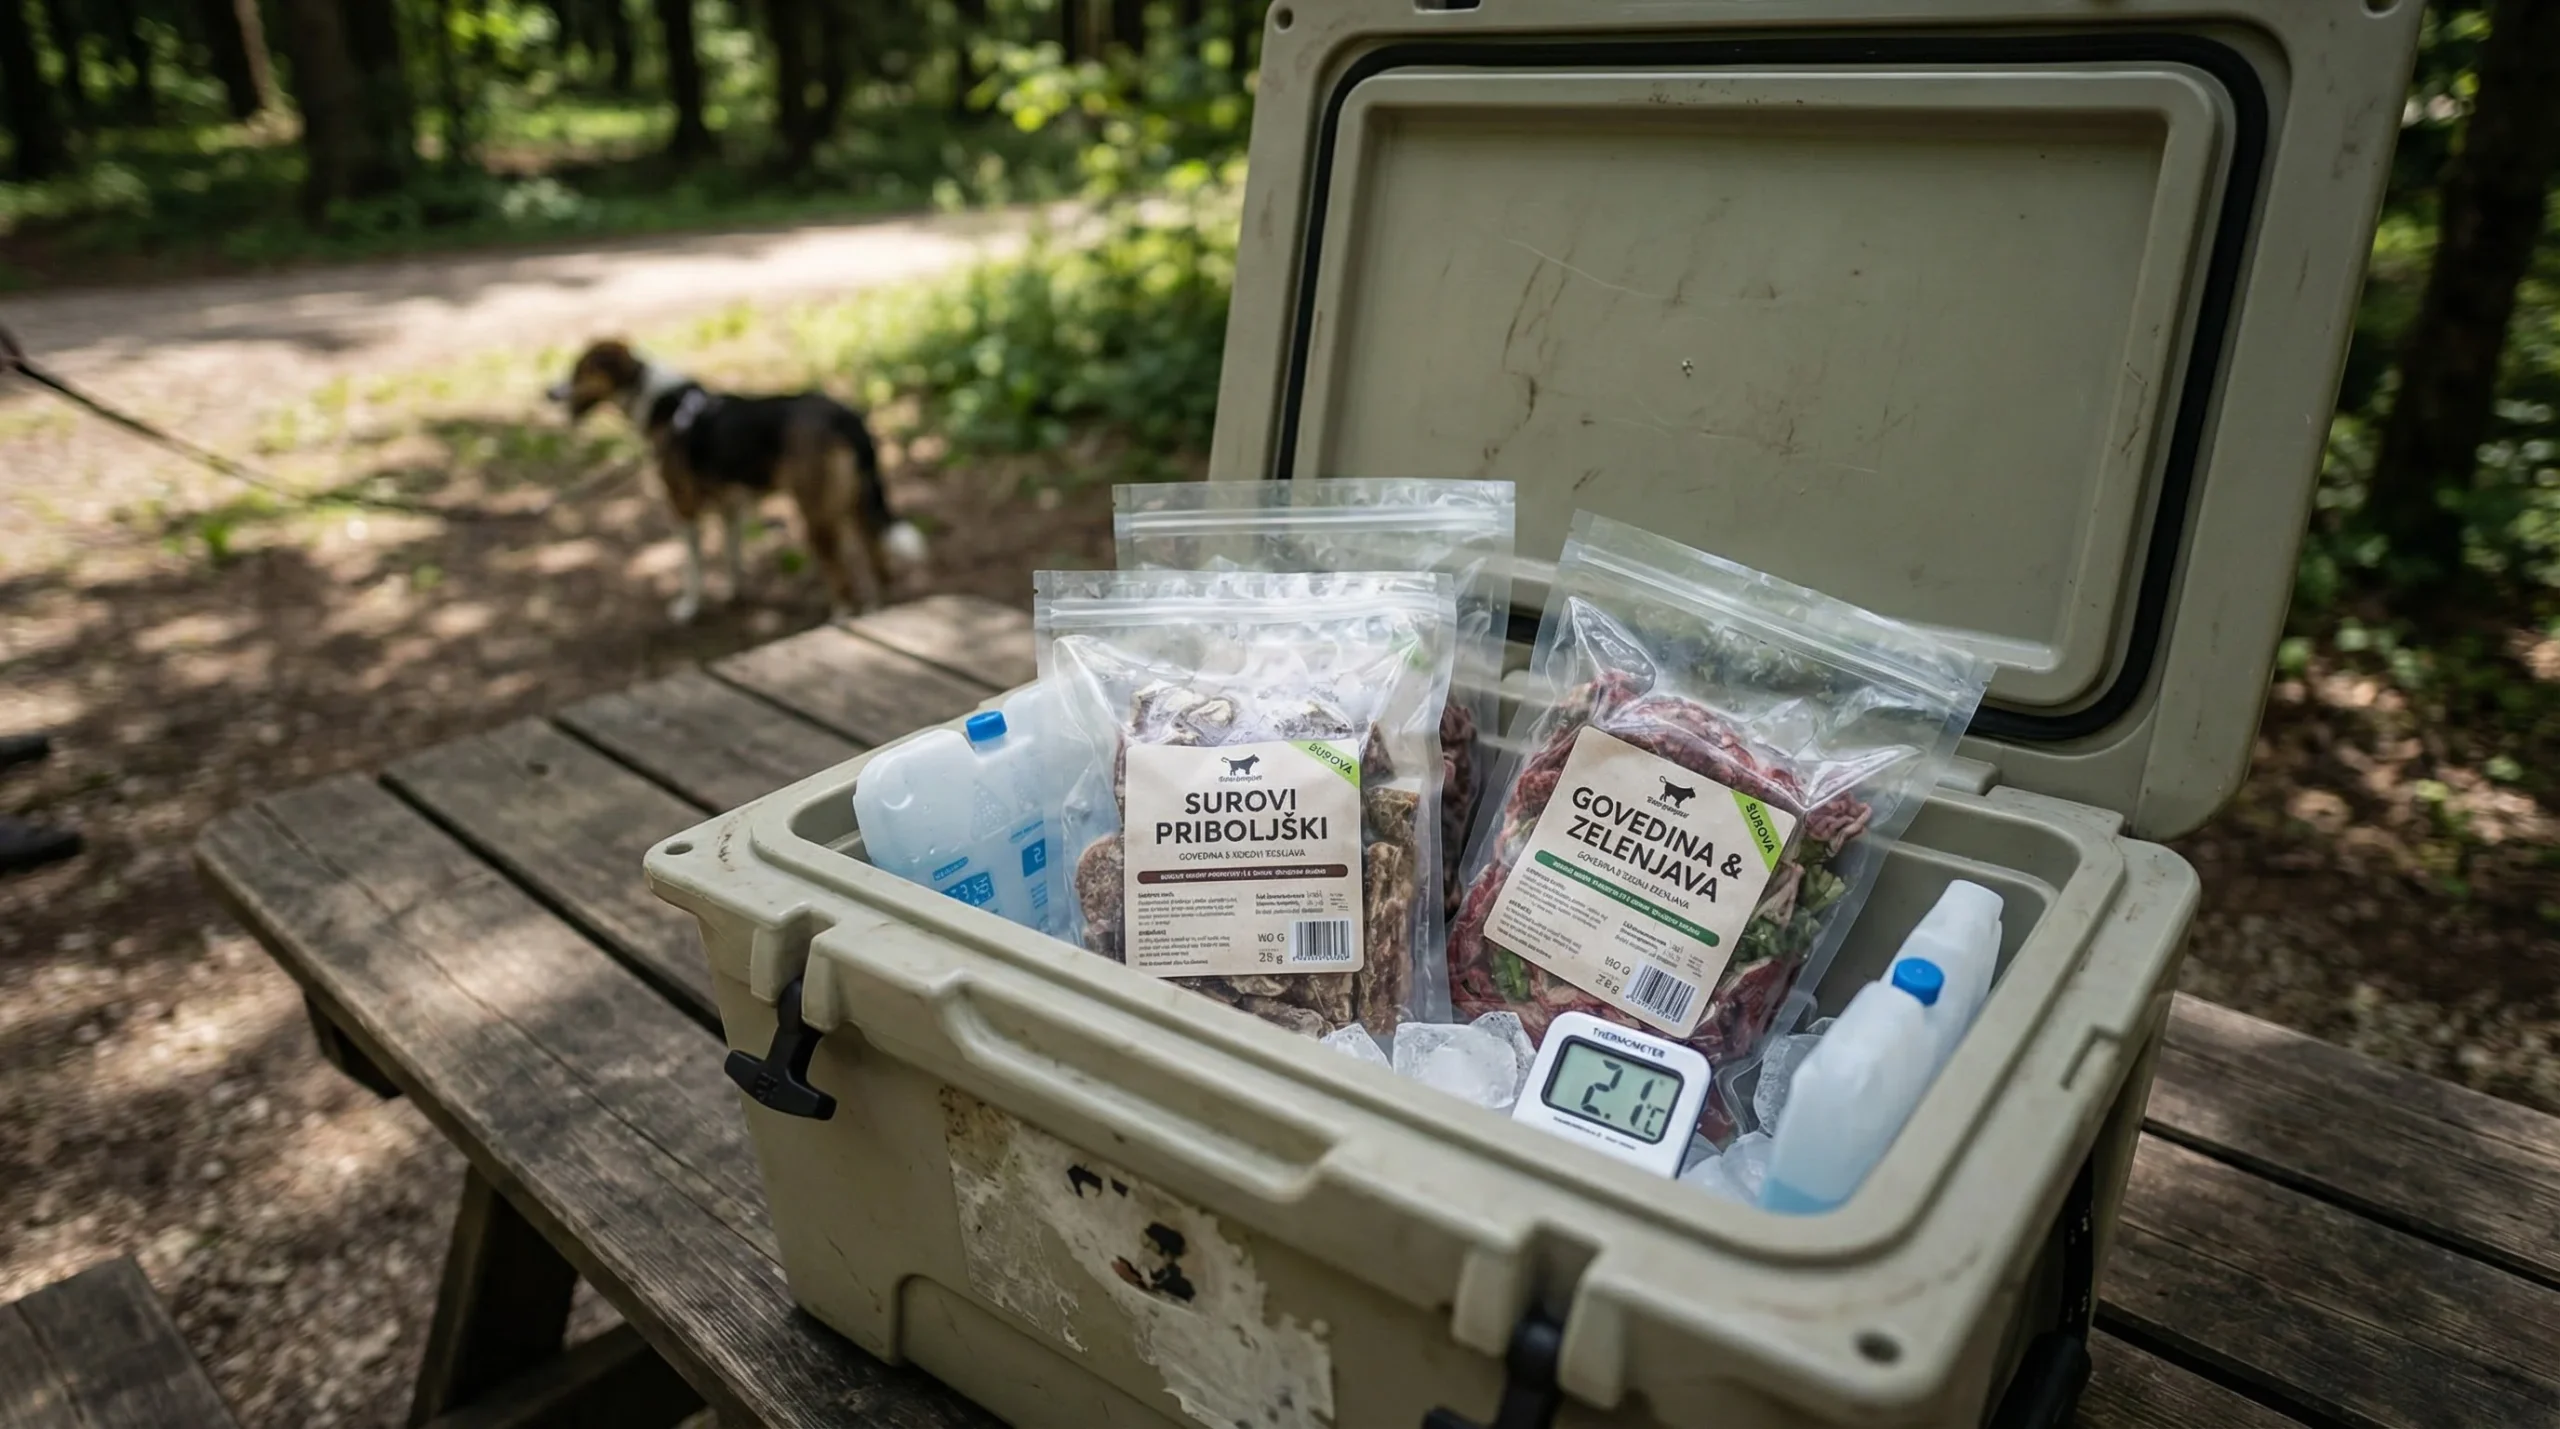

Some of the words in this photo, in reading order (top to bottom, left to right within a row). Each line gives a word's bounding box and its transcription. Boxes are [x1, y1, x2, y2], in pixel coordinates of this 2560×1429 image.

[1156, 812, 1327, 844] PRIBOLJŠKI
[1185, 789, 1296, 815] SUROVI
[1566, 814, 1717, 903] ZELENJAVA
[1572, 787, 1714, 868] GOVEDINA
[1720, 853, 1743, 880] &
